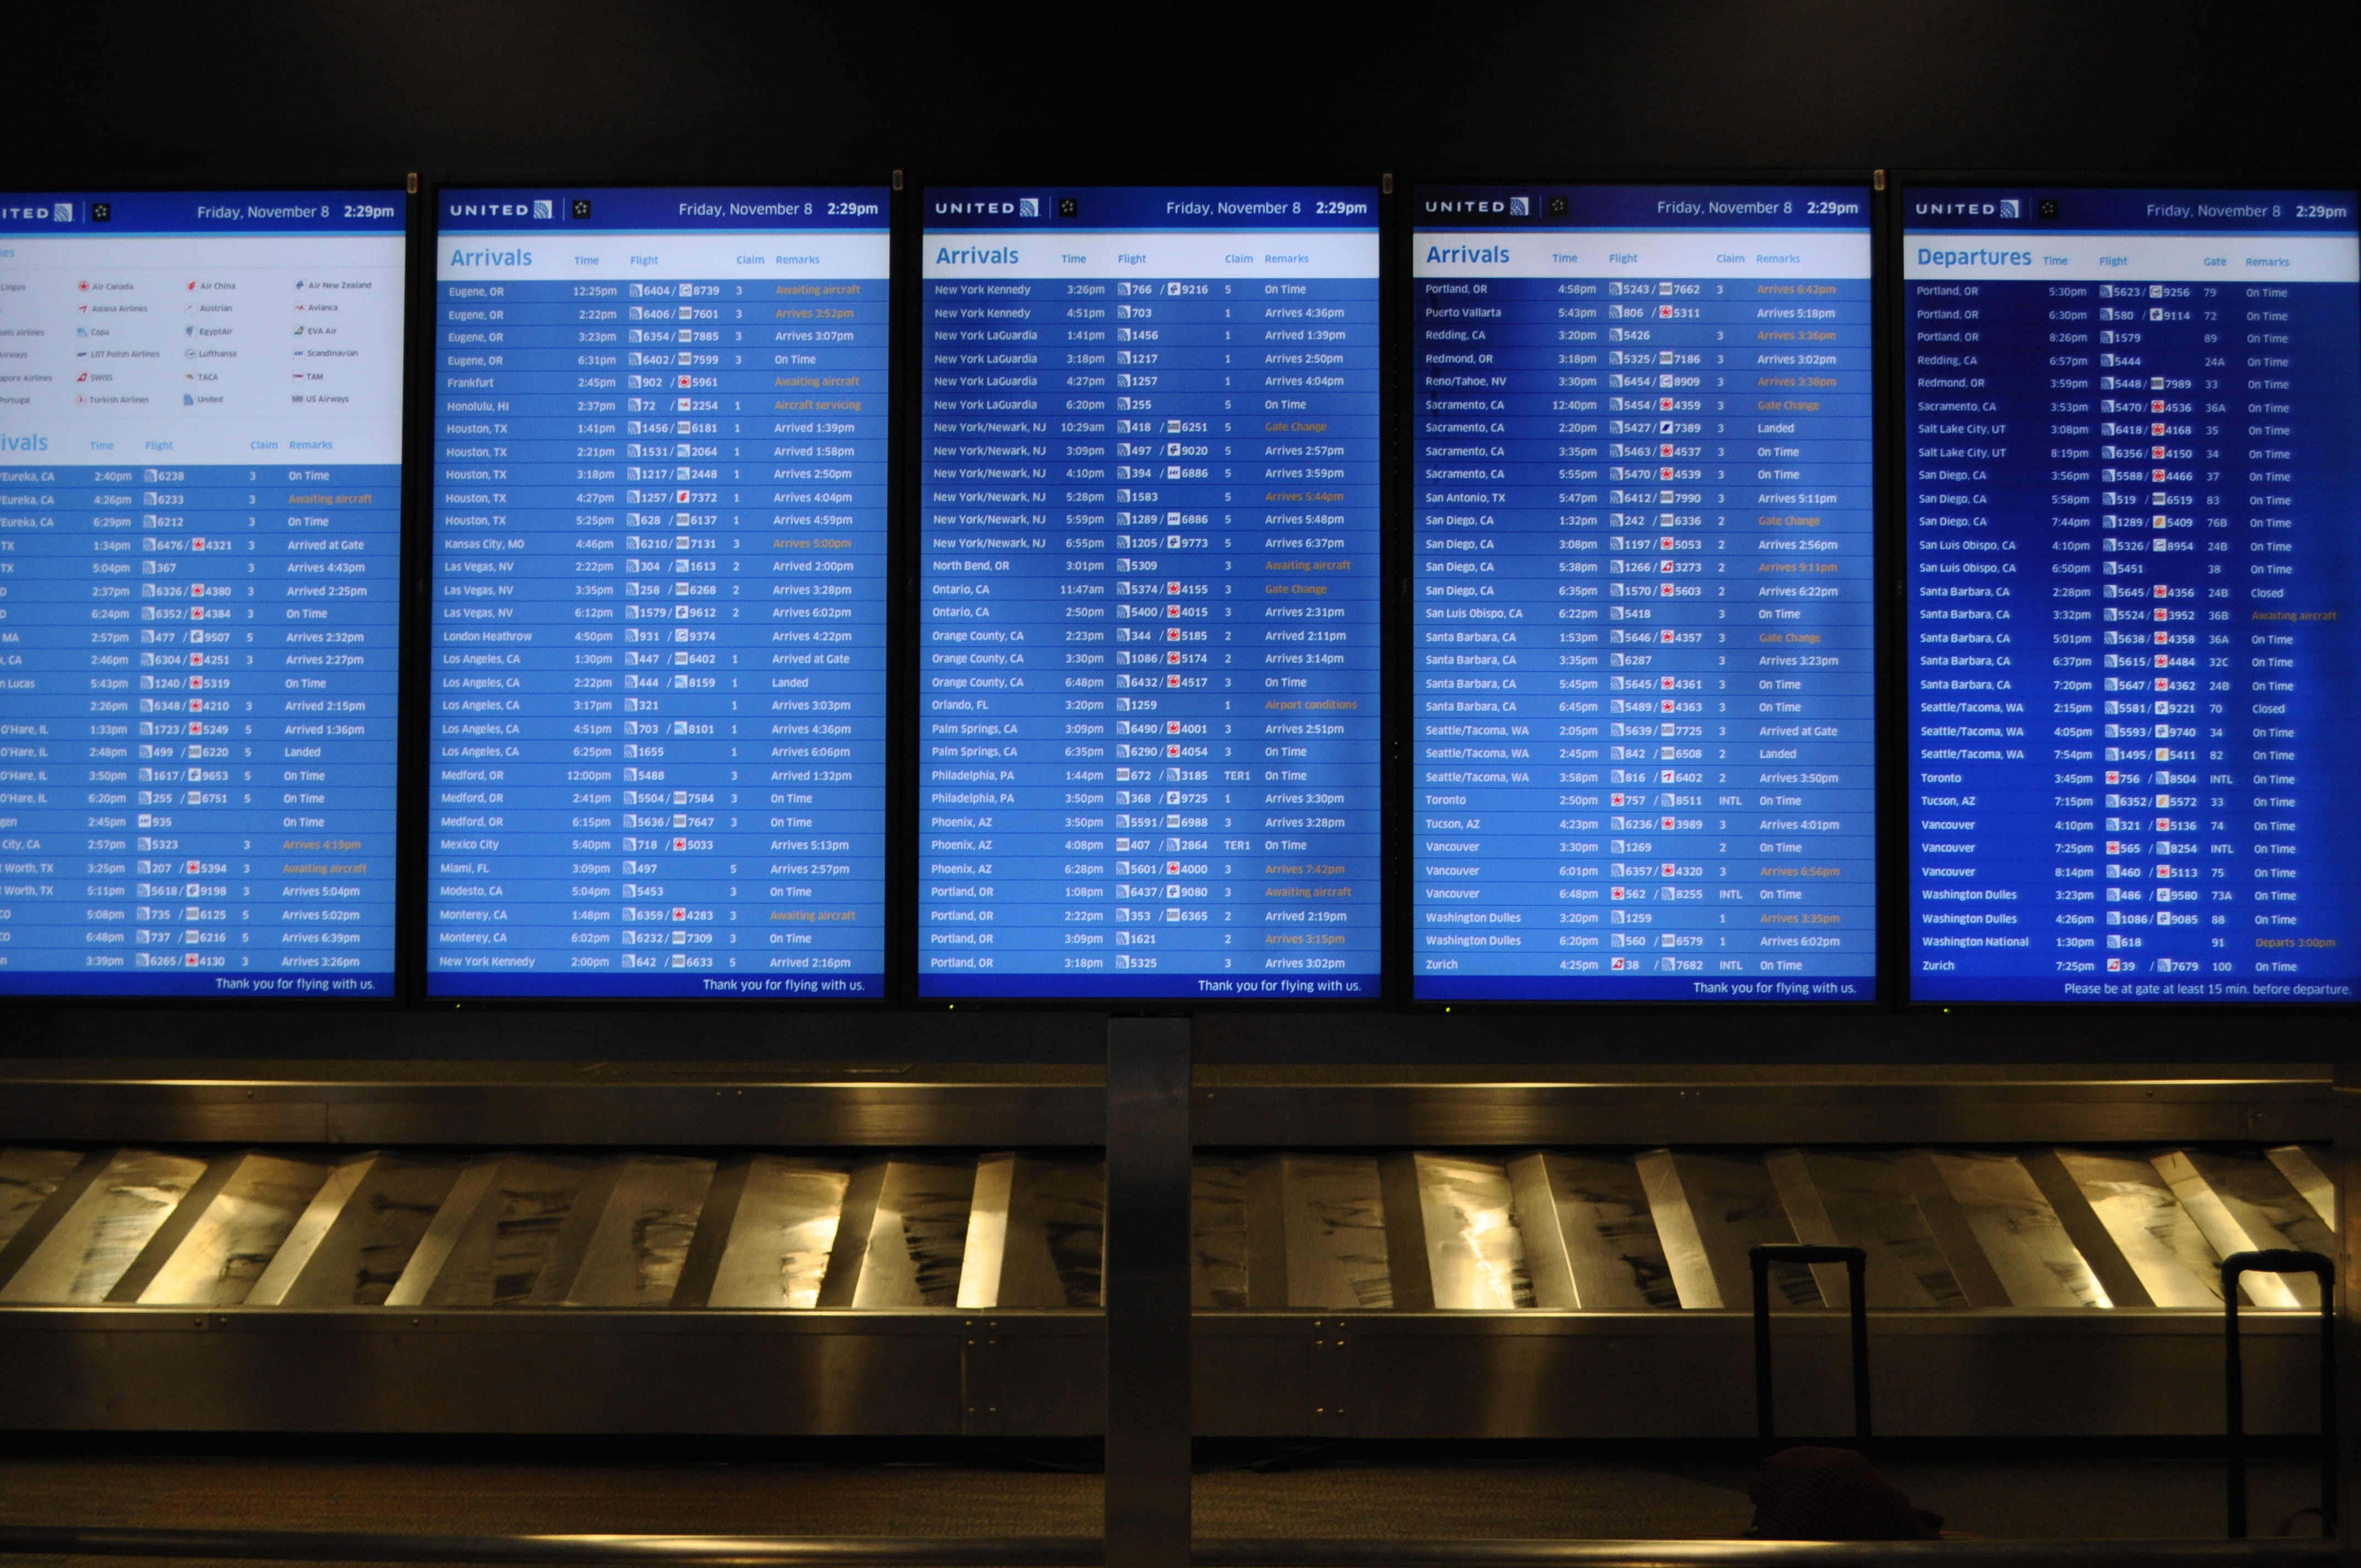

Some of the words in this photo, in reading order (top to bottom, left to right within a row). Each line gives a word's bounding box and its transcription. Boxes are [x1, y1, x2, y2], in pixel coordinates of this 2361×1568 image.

[198, 206, 244, 220] Friday,
[248, 205, 317, 218] November
[320, 205, 330, 218] 8
[344, 205, 394, 219] 2:29pm
[450, 204, 529, 216] UNITED
[679, 203, 726, 217] Friday,
[730, 203, 800, 215] November
[804, 203, 813, 215] 8
[828, 202, 878, 216] 2:29pm
[935, 203, 1014, 214] UNITED
[1167, 202, 1214, 216] Friday,
[1218, 202, 1288, 214] November
[1292, 202, 1301, 214] 8
[1316, 202, 1367, 216] 2:29pm
[1426, 201, 1505, 212] UNITED
[1657, 201, 1705, 216] Friday,
[1709, 202, 1780, 214] November
[1783, 201, 1793, 214] 8
[1807, 202, 1858, 216] 2:29pm
[1916, 204, 1995, 215] UNITED
[2147, 204, 2193, 219] Friday,
[2198, 205, 2268, 217] November
[2272, 205, 2281, 217] 8
[2296, 205, 2347, 219] 2:29pm
[450, 248, 532, 266] Arrivals
[574, 255, 599, 265] Time
[630, 255, 659, 266] Flight
[736, 255, 765, 264] Claim
[776, 255, 820, 264] Remarks
[936, 246, 1019, 264] Arrivals
[1062, 254, 1087, 264] Time
[1118, 254, 1146, 265] Flight
[1225, 254, 1254, 263] Claim
[1265, 254, 1309, 263] Remarks
[1426, 244, 1510, 263] Arrivals
[1552, 253, 1577, 263] Time
[1609, 253, 1638, 264] Flight
[1716, 254, 1745, 263] Claim
[1756, 254, 1800, 263] Remarks
[1918, 248, 2032, 268] Departures
[2043, 256, 2068, 265] Time
[2099, 257, 2128, 268] Flight
[2204, 257, 2227, 266] Gate
[2246, 257, 2290, 266] Remarks
[214, 282, 236, 290] China
[90, 328, 110, 336] Copa
[199, 328, 233, 336] EgyptAir
[90, 350, 105, 358] LOT
[199, 350, 237, 358] Lufthansa
[1917, 355, 1961, 367] Redding,
[1963, 356, 1978, 365] CA
[2049, 356, 2088, 367] 6:57pm
[2114, 357, 2141, 366] 5444
[2205, 357, 2226, 367] 24A
[2247, 357, 2261, 367] On
[2263, 357, 2289, 367] Time
[448, 378, 494, 388] Frankfurt
[306, 395, 317, 403] US
[318, 395, 349, 404] Airways
[89, 441, 115, 450] Time
[145, 440, 173, 451] Flight
[250, 440, 278, 450] Claim
[289, 440, 333, 449] Remarks
[93, 563, 130, 574] 5:04pm
[157, 563, 176, 573] 367
[248, 562, 255, 573] 3
[287, 563, 324, 573] Arrives
[327, 563, 365, 573] 4:43pm
[933, 560, 962, 570] North
[964, 560, 992, 571] Bend,
[994, 560, 1009, 570] OR
[1066, 560, 1105, 572] 3:01pm
[1131, 560, 1157, 570] 5309
[1225, 560, 1232, 570] 3
[1266, 561, 1311, 571] Awaiting
[1313, 560, 1351, 570] aircraft
[1426, 608, 1444, 618] San
[1446, 608, 1467, 618] Luis
[1469, 608, 1506, 620] Obispo,
[1509, 608, 1523, 618] CA
[1559, 608, 1598, 620] 6:22pm
[1625, 609, 1651, 619] 5418
[1718, 609, 1726, 619] 3
[1759, 609, 1772, 619] On
[1775, 609, 1801, 619] Time
[443, 701, 460, 710] Los
[461, 700, 504, 712] Angeles,
[505, 700, 520, 710] CA
[574, 700, 612, 712] 3:17pm
[639, 700, 659, 710] 321
[732, 700, 737, 710] 1
[771, 700, 810, 710] Arrives
[812, 700, 851, 712] 3:03pm
[1426, 795, 1466, 805] Toronto
[1923, 960, 1955, 971] Zurich
[215, 977, 250, 989] Thank
[253, 979, 274, 991] you
[277, 978, 294, 989] for
[296, 978, 329, 991] flying
[332, 978, 357, 989] with
[360, 980, 375, 989] us.
[703, 978, 737, 990] Thank
[741, 981, 763, 992] you
[765, 978, 782, 990] for
[785, 979, 818, 992] flying
[821, 979, 846, 990] with
[849, 981, 864, 990] us.
[1198, 979, 1233, 991] Thank
[1236, 982, 1258, 993] you
[1260, 979, 1278, 991] for
[1281, 979, 1314, 993] flying
[1317, 980, 1343, 991] with
[1346, 982, 1361, 991] us.
[1693, 982, 1728, 993] Thank
[1731, 984, 1753, 995] you
[1756, 982, 1774, 993] for
[1776, 982, 1809, 995] flying
[1812, 982, 1838, 993] with
[1841, 984, 1856, 993] us.
[2064, 983, 2102, 994] Please
[2104, 983, 2119, 994] be
[2121, 984, 2132, 994] at
[2135, 984, 2160, 996] gate
[2163, 984, 2174, 994] at
[2177, 983, 2204, 994] least
[2208, 983, 2223, 994] 15
[2226, 986, 2249, 994] min.
[2253, 983, 2291, 995] before
[2293, 984, 2351, 996] departure.
